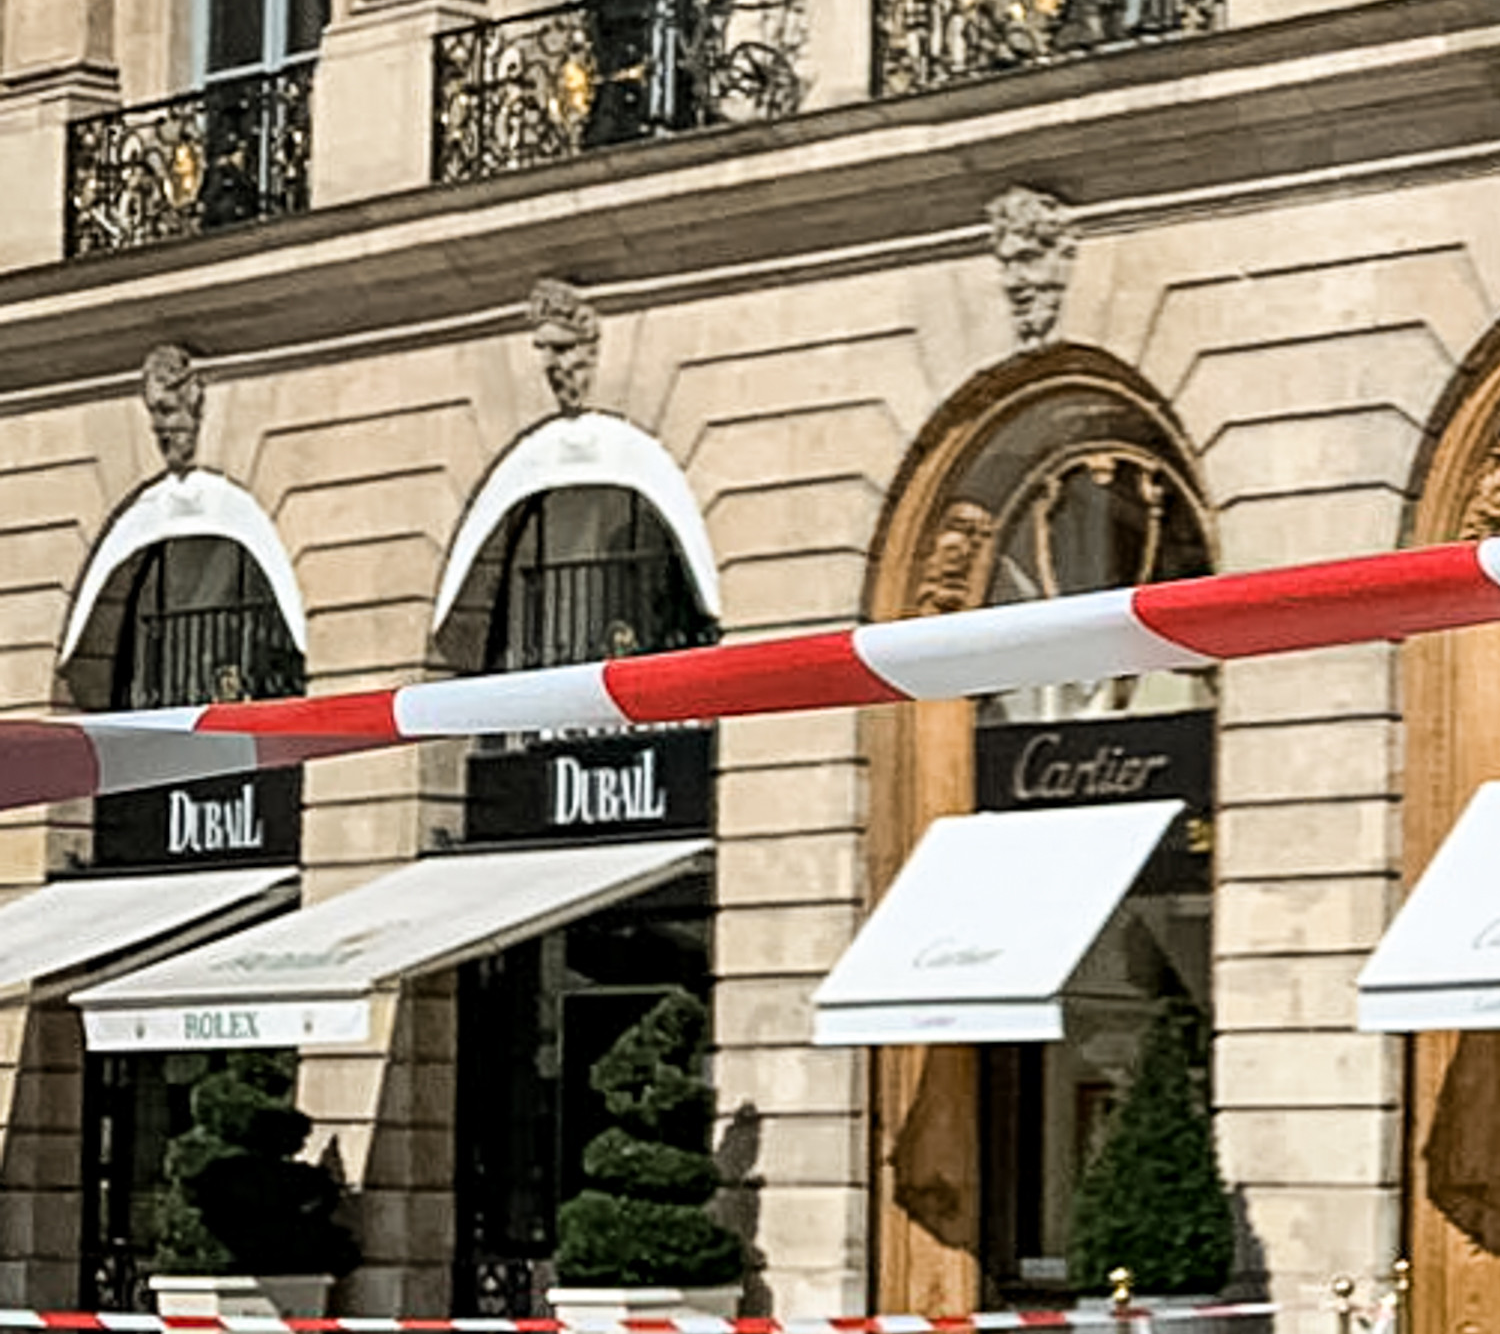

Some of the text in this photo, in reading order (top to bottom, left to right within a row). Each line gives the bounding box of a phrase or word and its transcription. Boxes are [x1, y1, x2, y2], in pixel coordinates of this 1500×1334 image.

[554, 748, 666, 825] DUBAIL
[1013, 732, 1169, 800] Cartier
[183, 1010, 260, 1040] ROLEX
